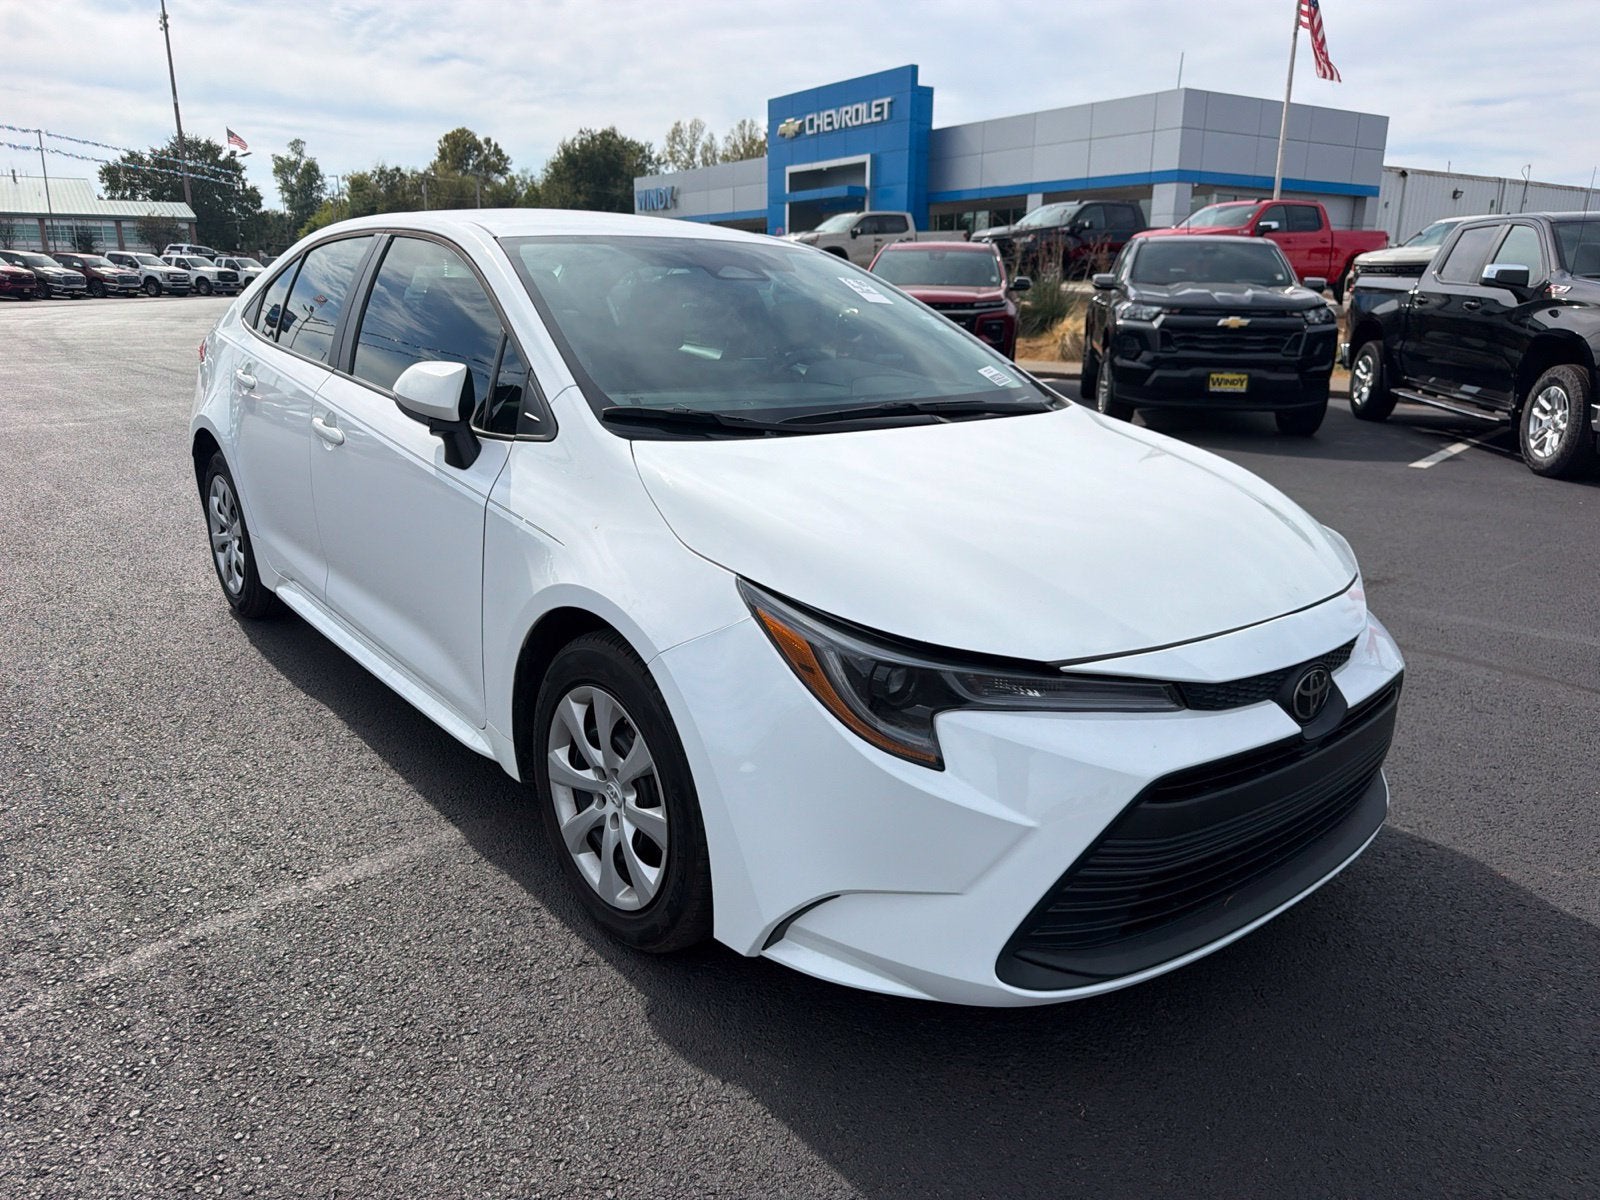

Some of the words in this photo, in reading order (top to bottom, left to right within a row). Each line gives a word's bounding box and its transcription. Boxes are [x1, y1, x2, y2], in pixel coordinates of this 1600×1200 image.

[805, 97, 893, 135] CHEVROLET
[636, 187, 675, 211] WINDY
[1210, 377, 1247, 387] WINDY
